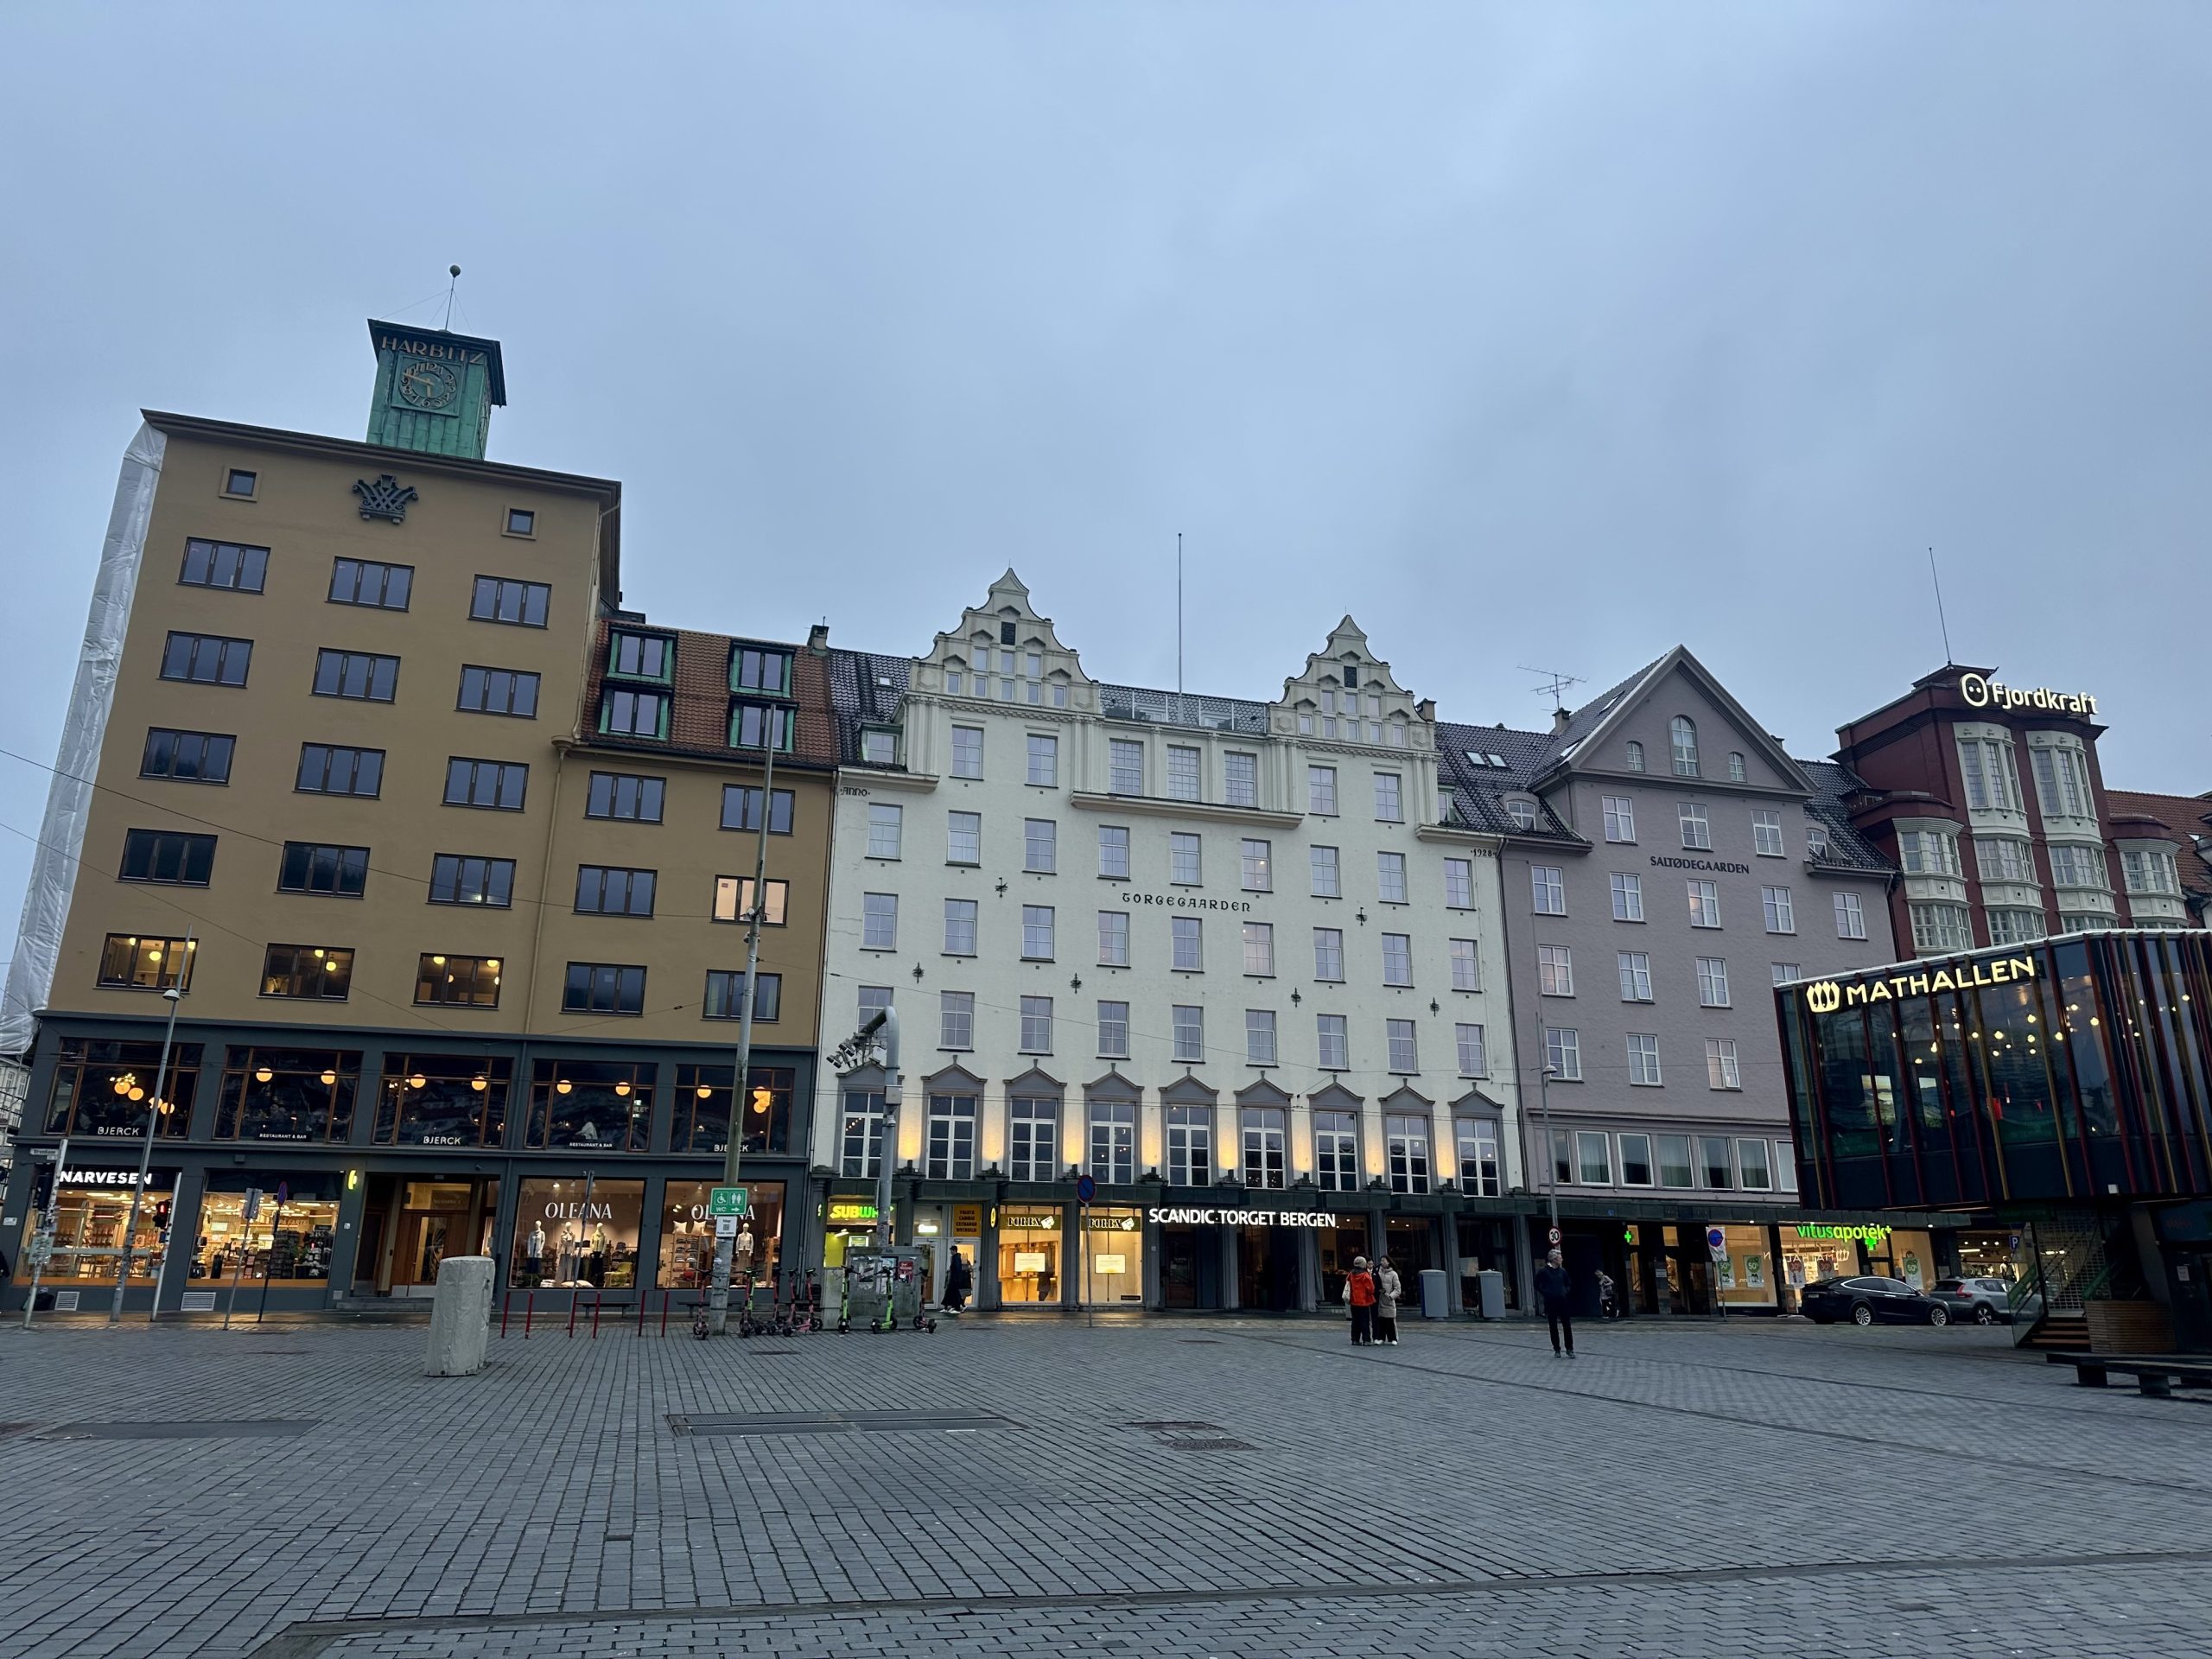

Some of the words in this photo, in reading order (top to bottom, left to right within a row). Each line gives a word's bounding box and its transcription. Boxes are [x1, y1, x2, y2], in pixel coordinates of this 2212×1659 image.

[381, 336, 485, 364] HARBITZ
[1991, 682, 2099, 714] Fjordkraft
[1473, 849, 1493, 858] 1928
[1649, 856, 1750, 874] SALTØDEGAARDEN
[1122, 893, 1251, 912] TORGEGAARDEN
[1846, 956, 2035, 1006] MATHALLEN
[97, 1126, 140, 1136] BJERCK
[423, 1135, 461, 1145] BJERCK
[713, 1143, 749, 1153] BJEK
[59, 1171, 153, 1185] NARVESEN
[544, 1202, 613, 1219] OLEANA
[1007, 1217, 1041, 1227] FOREX
[1088, 1218, 1123, 1229] FOREX
[1148, 1208, 1215, 1224] SCANDIC
[1217, 1210, 1276, 1226] TORGET
[1280, 1211, 1336, 1228] BERGEN
[1550, 1230, 1560, 1242] 30
